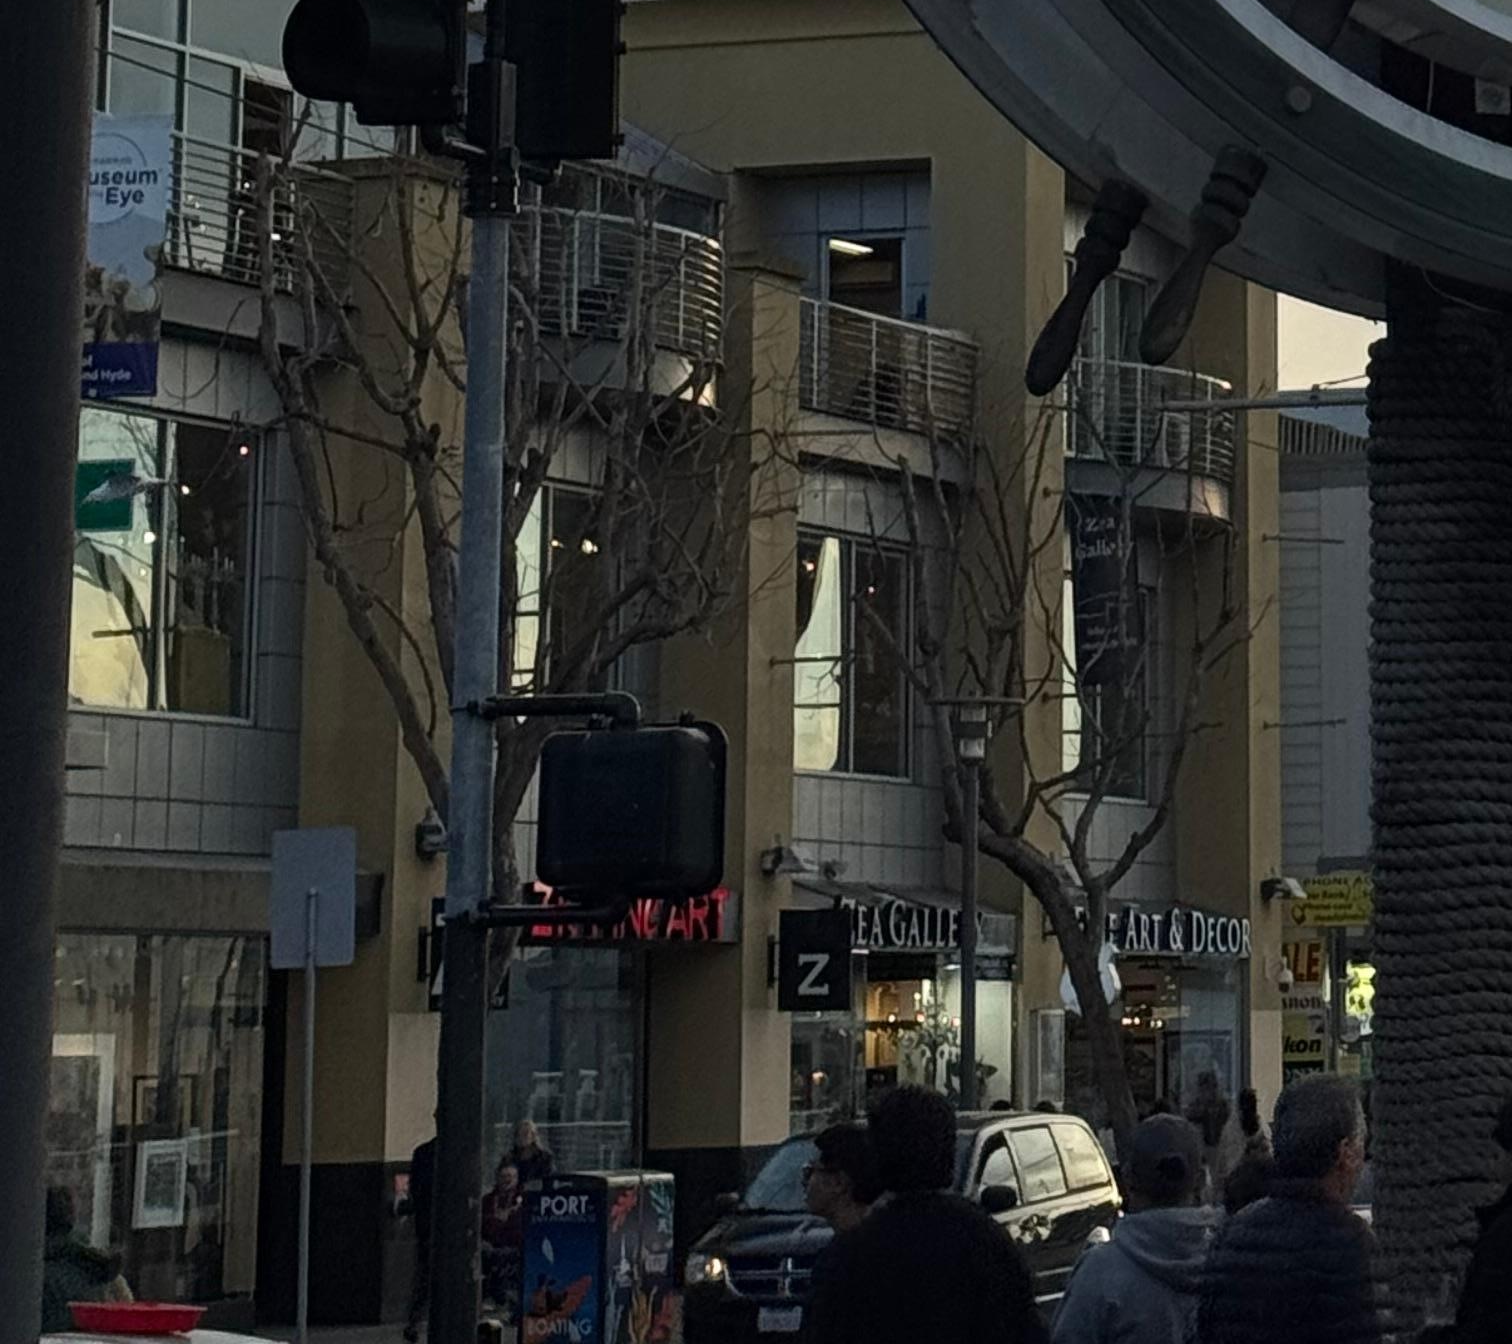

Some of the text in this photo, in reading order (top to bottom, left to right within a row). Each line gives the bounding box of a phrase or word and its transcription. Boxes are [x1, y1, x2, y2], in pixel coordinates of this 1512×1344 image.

[90, 170, 157, 186] useum
[106, 187, 144, 207] Eye
[667, 887, 730, 941] ART
[889, 900, 985, 948] GALLEY
[1125, 909, 1163, 950] ART
[1169, 907, 1185, 952] &
[1191, 910, 1251, 955] DECOR
[797, 953, 831, 995] Z
[1284, 1035, 1322, 1052] kon
[541, 1195, 589, 1216] PORT
